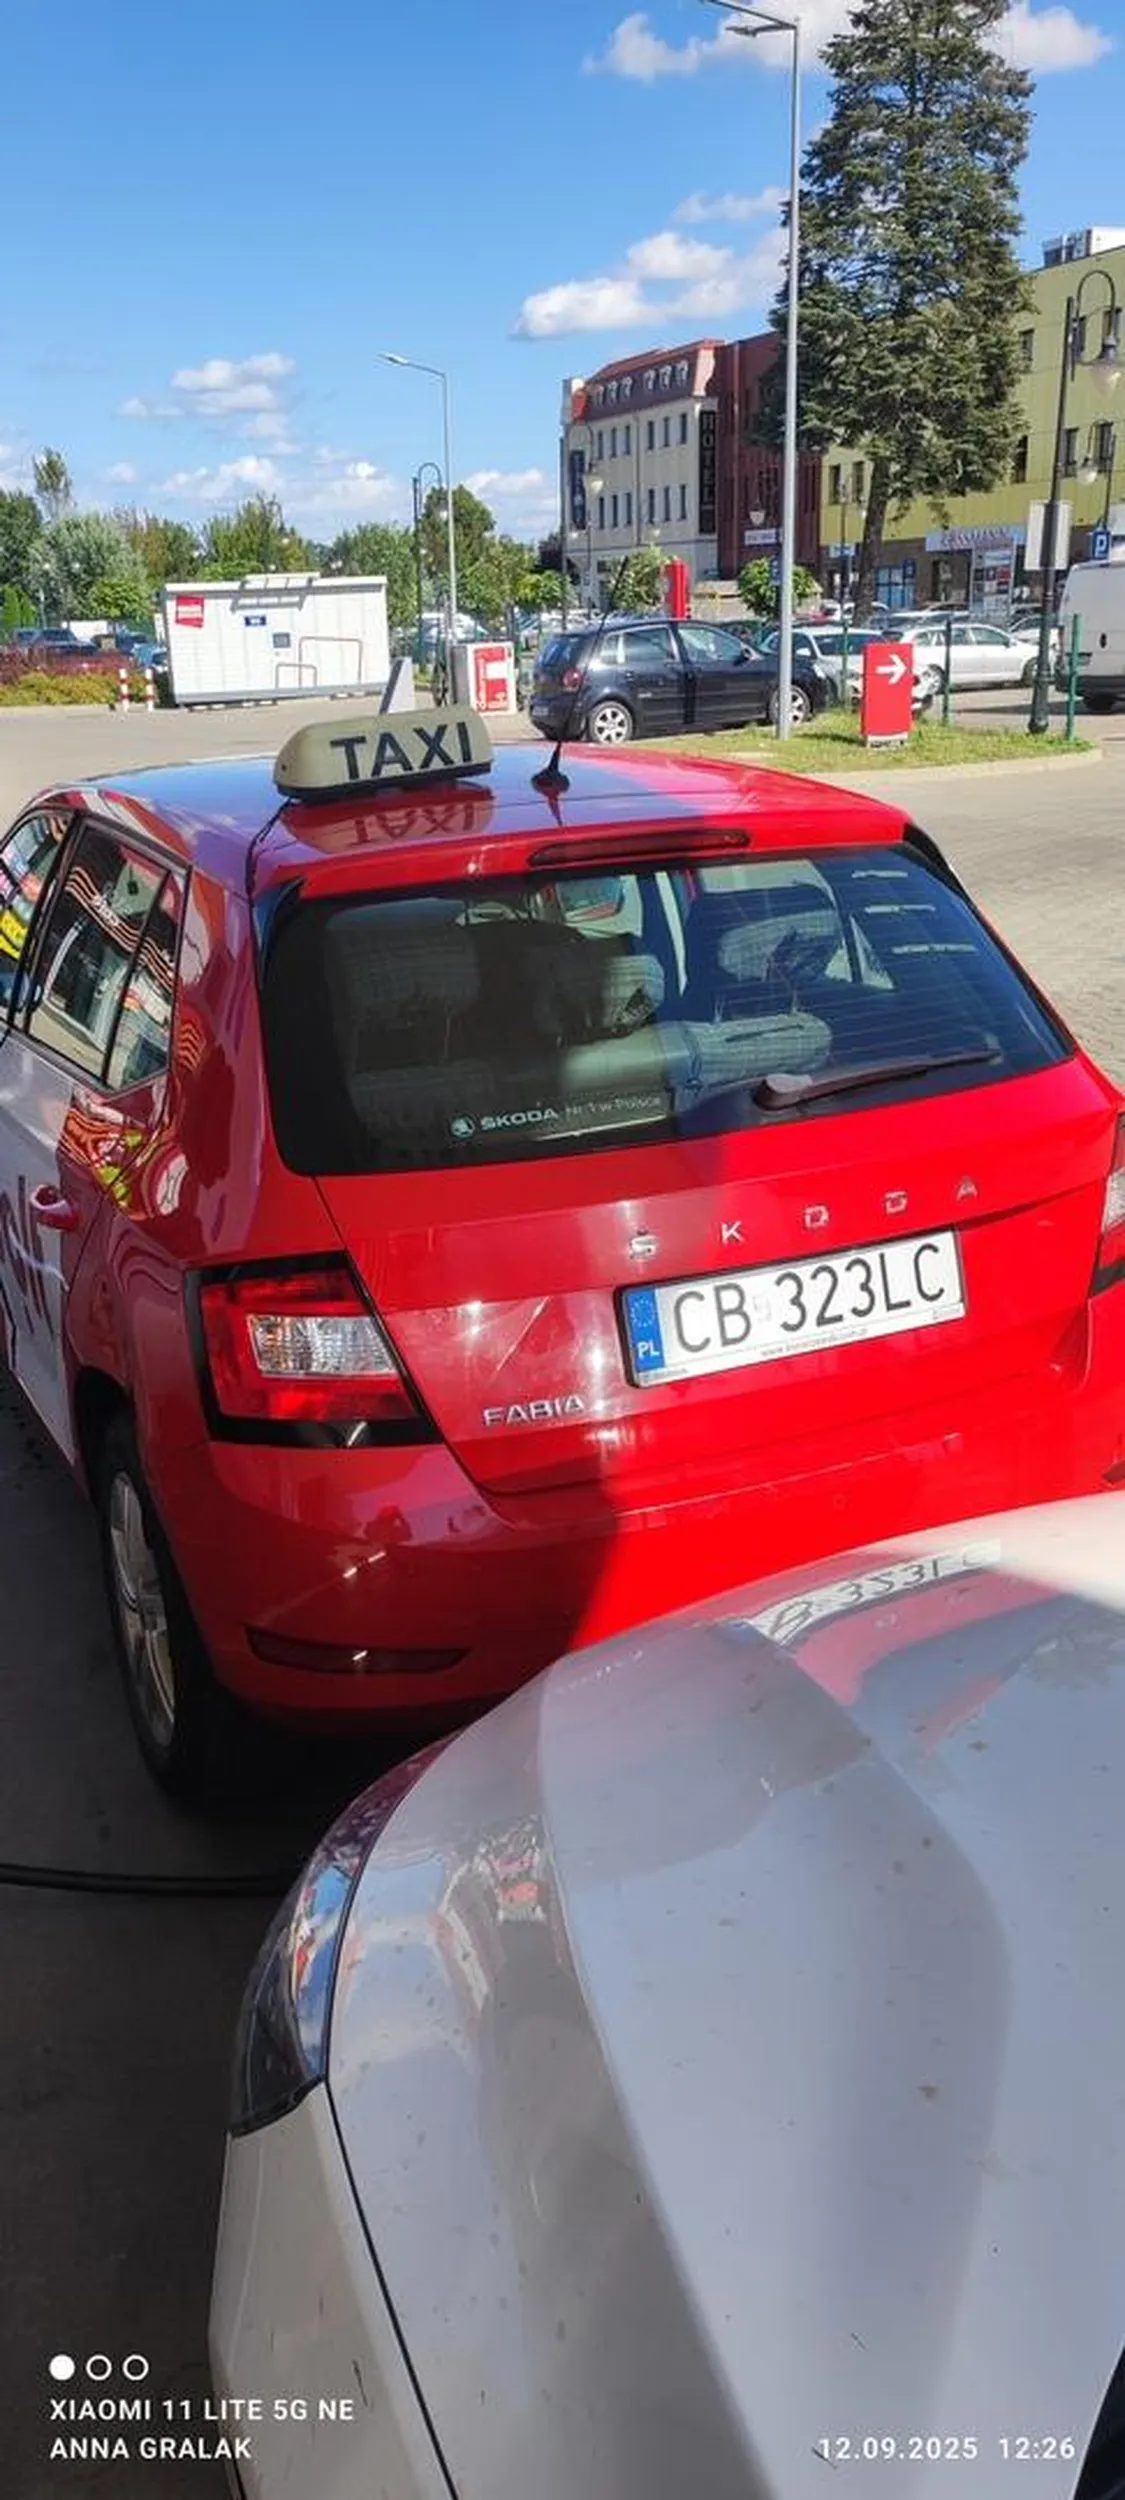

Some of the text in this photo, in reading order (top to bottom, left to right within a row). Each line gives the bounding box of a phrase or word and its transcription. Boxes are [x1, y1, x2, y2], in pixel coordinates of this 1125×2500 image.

[702, 413, 715, 503] HOTEL
[330, 721, 474, 781] TAXI
[673, 1242, 946, 1353] CB 323LC
[638, 1341, 660, 1360] PL
[483, 1394, 585, 1427] FABIA
